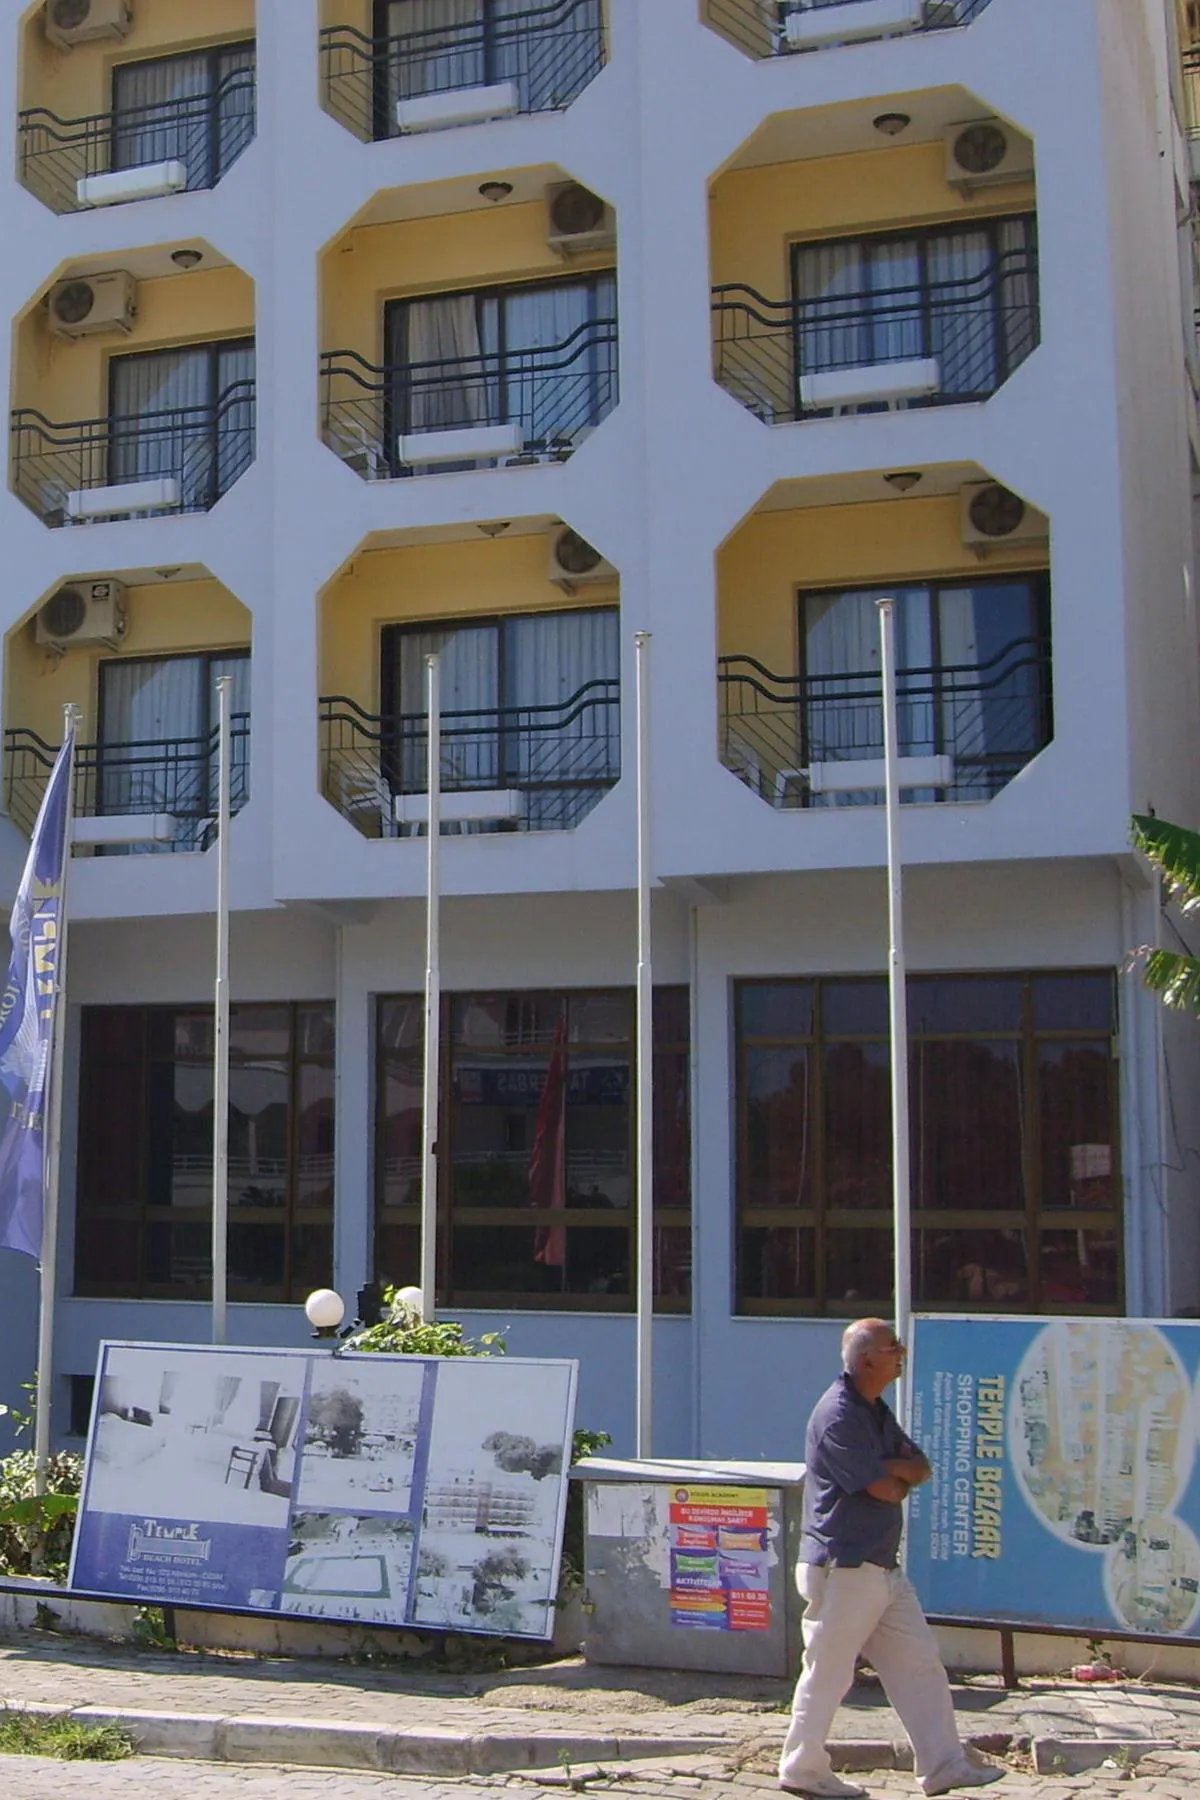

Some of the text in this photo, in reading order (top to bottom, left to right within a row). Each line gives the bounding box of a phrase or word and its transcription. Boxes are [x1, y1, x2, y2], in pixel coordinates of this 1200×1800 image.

[143, 1519, 200, 1541] TEMPLE
[953, 1374, 973, 1556] SHOPPING CENTER
[971, 1375, 1005, 1560] TEMPLE BAZAAR
